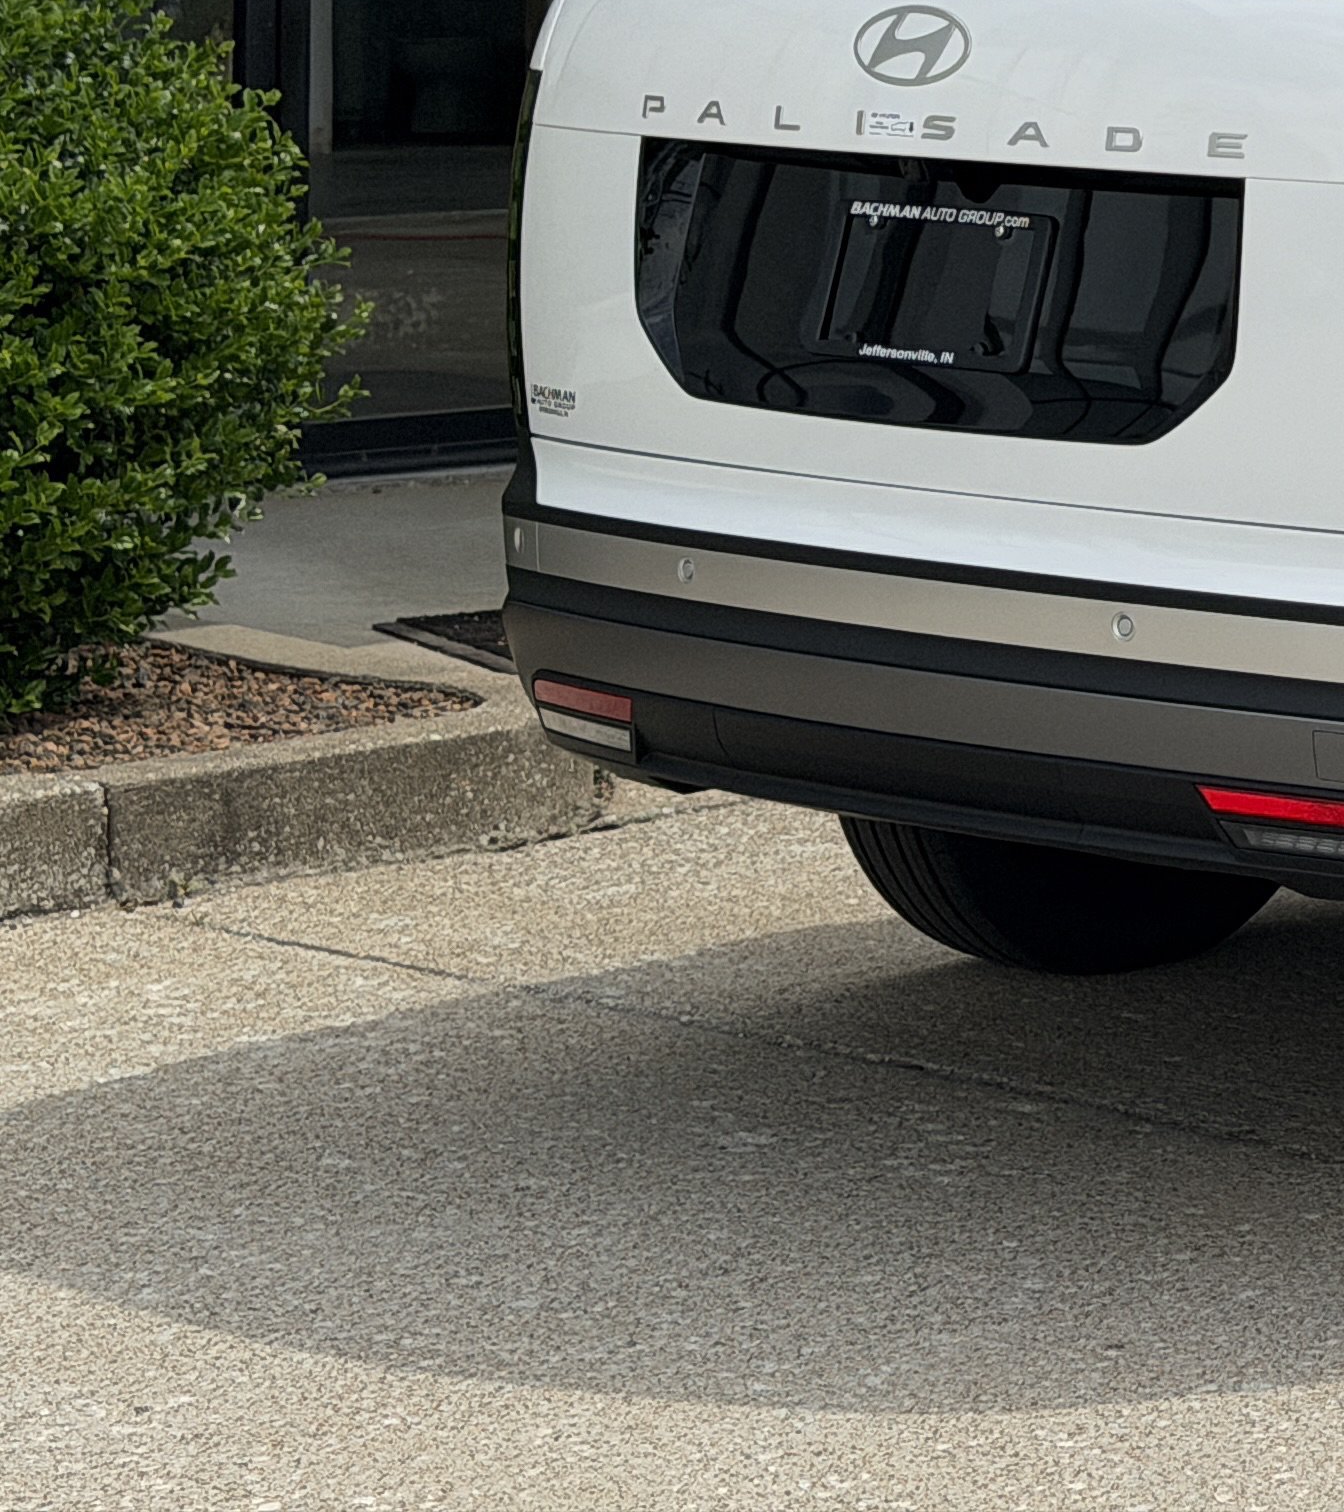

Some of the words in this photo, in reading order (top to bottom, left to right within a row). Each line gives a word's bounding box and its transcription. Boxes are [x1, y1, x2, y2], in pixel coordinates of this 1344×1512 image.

[643, 94, 1249, 159] PALISADE
[850, 201, 921, 219] BACHMAN
[921, 206, 957, 223] AUTO
[940, 352, 954, 364] IN
[533, 384, 576, 404] BACHMAN
